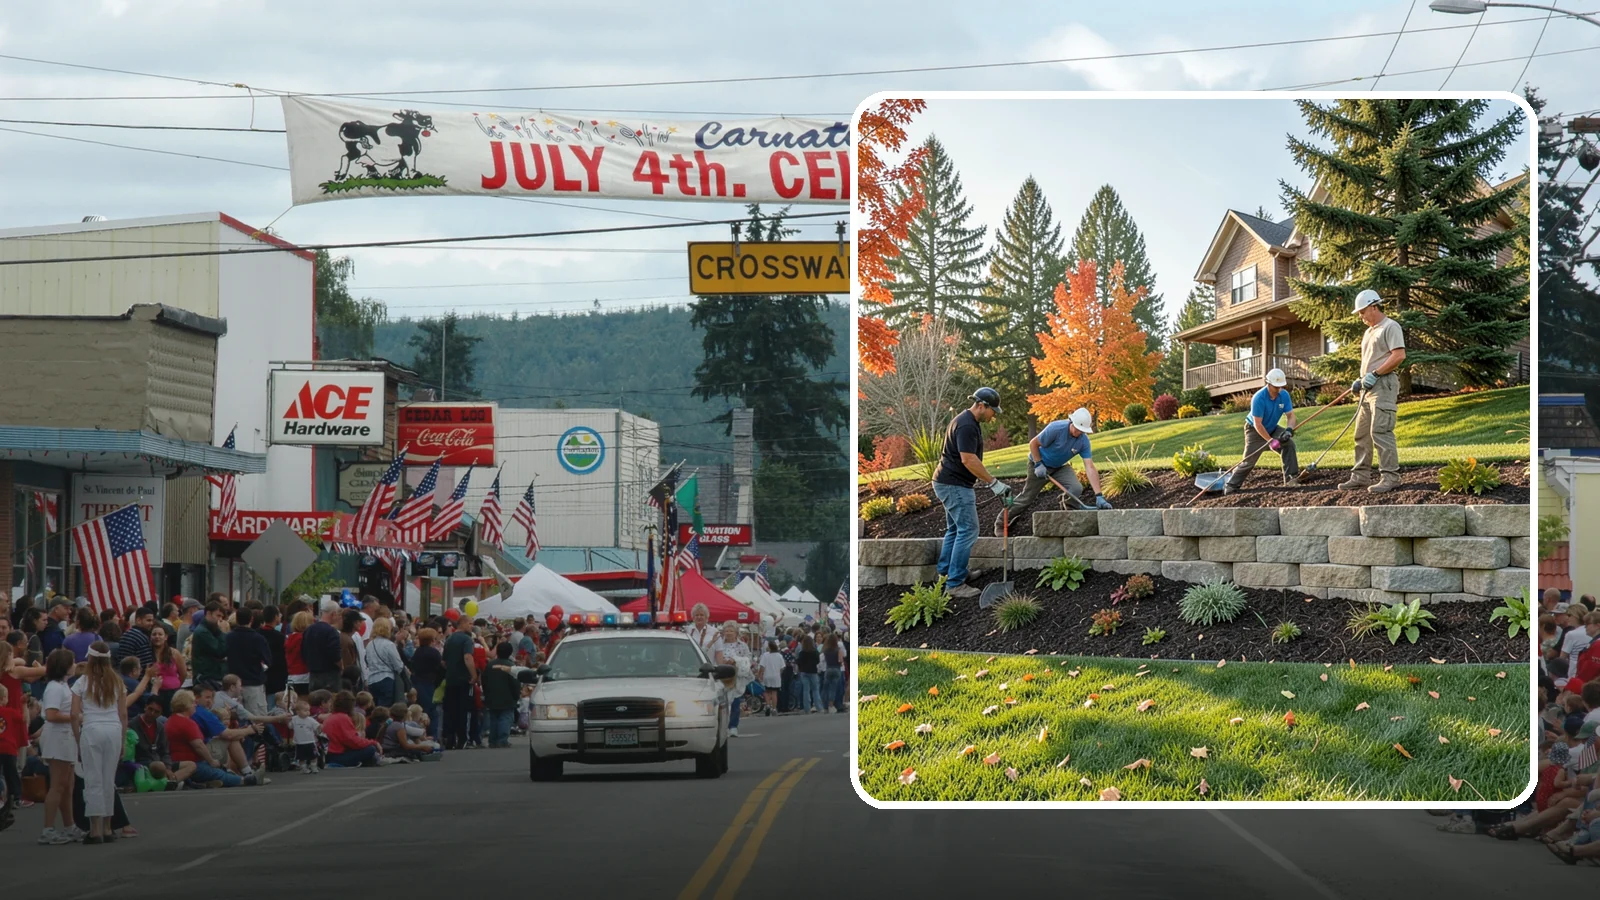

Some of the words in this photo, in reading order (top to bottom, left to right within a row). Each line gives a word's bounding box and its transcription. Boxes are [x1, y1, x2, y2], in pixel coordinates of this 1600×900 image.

[694, 121, 851, 150] Carnat
[481, 140, 605, 194] JULY
[632, 149, 747, 198] 4th.
[696, 253, 851, 281] CROSSWA
[283, 380, 373, 420] ACE
[405, 409, 453, 422] CEDAR
[460, 409, 486, 422] LOG
[283, 421, 371, 436] Hardware
[416, 428, 477, 447] Coca-Cola
[353, 466, 385, 481] Simpl
[95, 484, 125, 495] Vincent
[126, 485, 136, 495] de
[137, 485, 155, 495] Paul
[688, 526, 741, 535] CRNATION
[699, 535, 731, 543] GLASS
